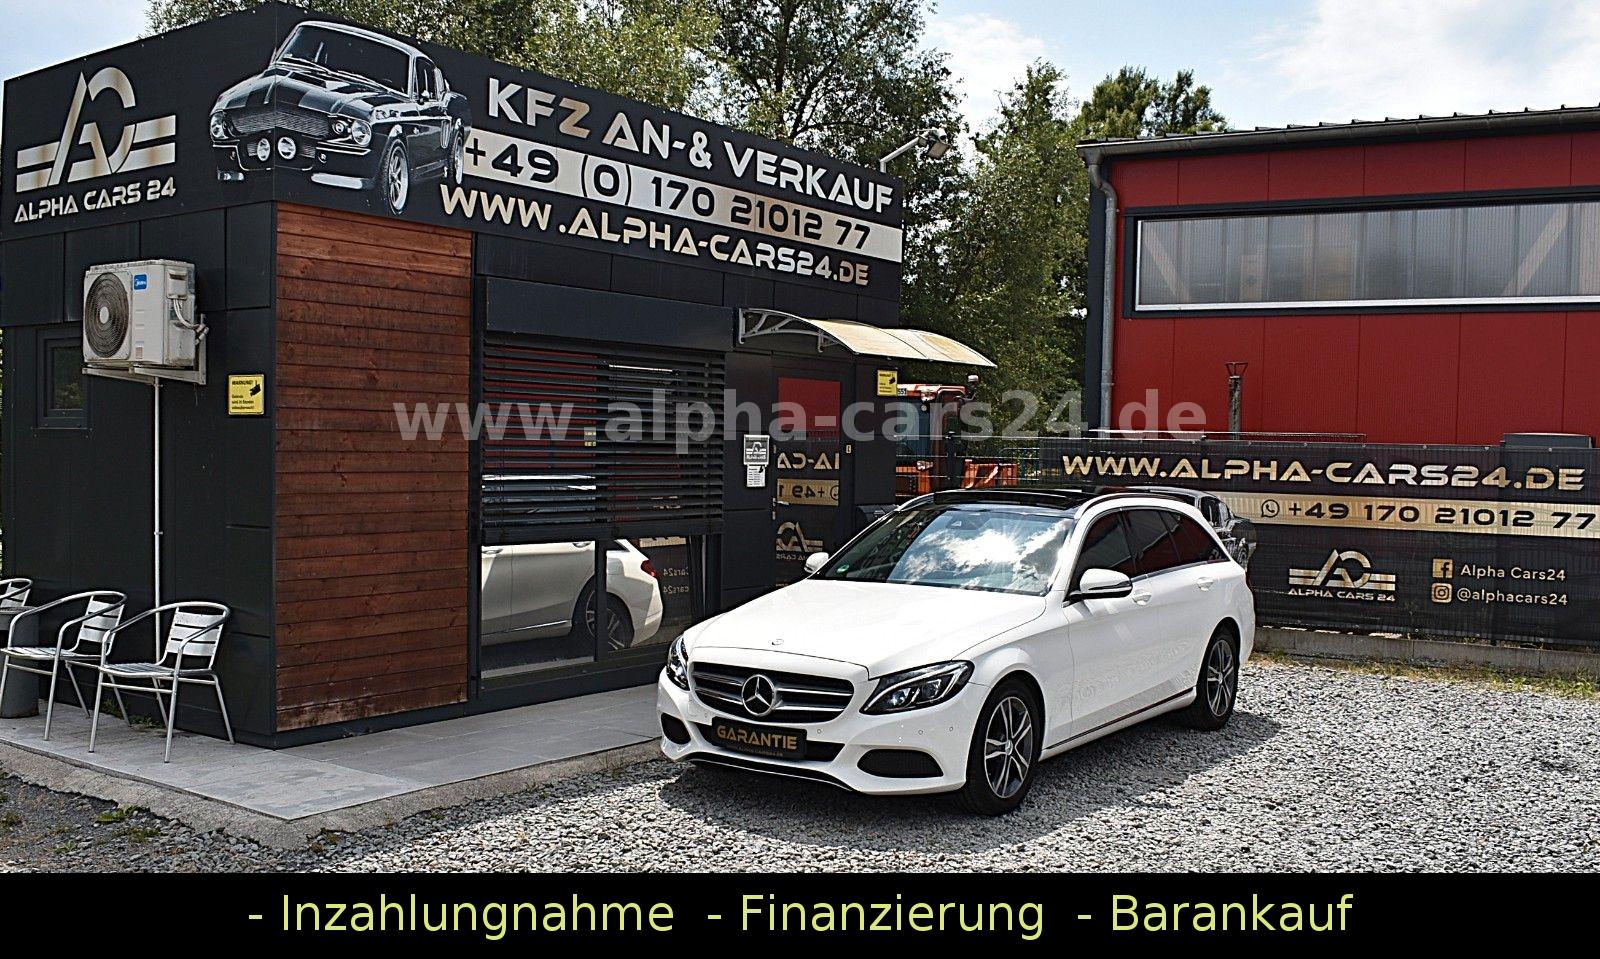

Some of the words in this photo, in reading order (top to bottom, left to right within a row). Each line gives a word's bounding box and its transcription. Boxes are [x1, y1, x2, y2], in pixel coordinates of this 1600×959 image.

[488, 78, 591, 139] KFZ
[724, 141, 894, 213] VERKAUF
[15, 194, 79, 223] ALPHA
[83, 182, 140, 211] CARS
[146, 176, 177, 201] 24
[465, 138, 559, 183] +49
[581, 155, 632, 206] (0)
[652, 177, 715, 216] 170
[730, 194, 823, 236] 21012
[835, 219, 870, 250] 77
[1062, 455, 1585, 492] WWW.ALPHA-CARS24.DE
[1289, 501, 1349, 520] +49
[1363, 504, 1420, 523] 170
[1434, 506, 1535, 528] 21012
[1551, 511, 1597, 531] 77
[1460, 564, 1505, 580] Alpha
[1511, 566, 1566, 581] Cars24
[1288, 589, 1333, 598] ALPHA
[1337, 591, 1374, 600] CARS
[1377, 594, 1396, 602] 24
[1457, 588, 1568, 606] @alphacars24
[717, 725, 797, 750] GARANTIE
